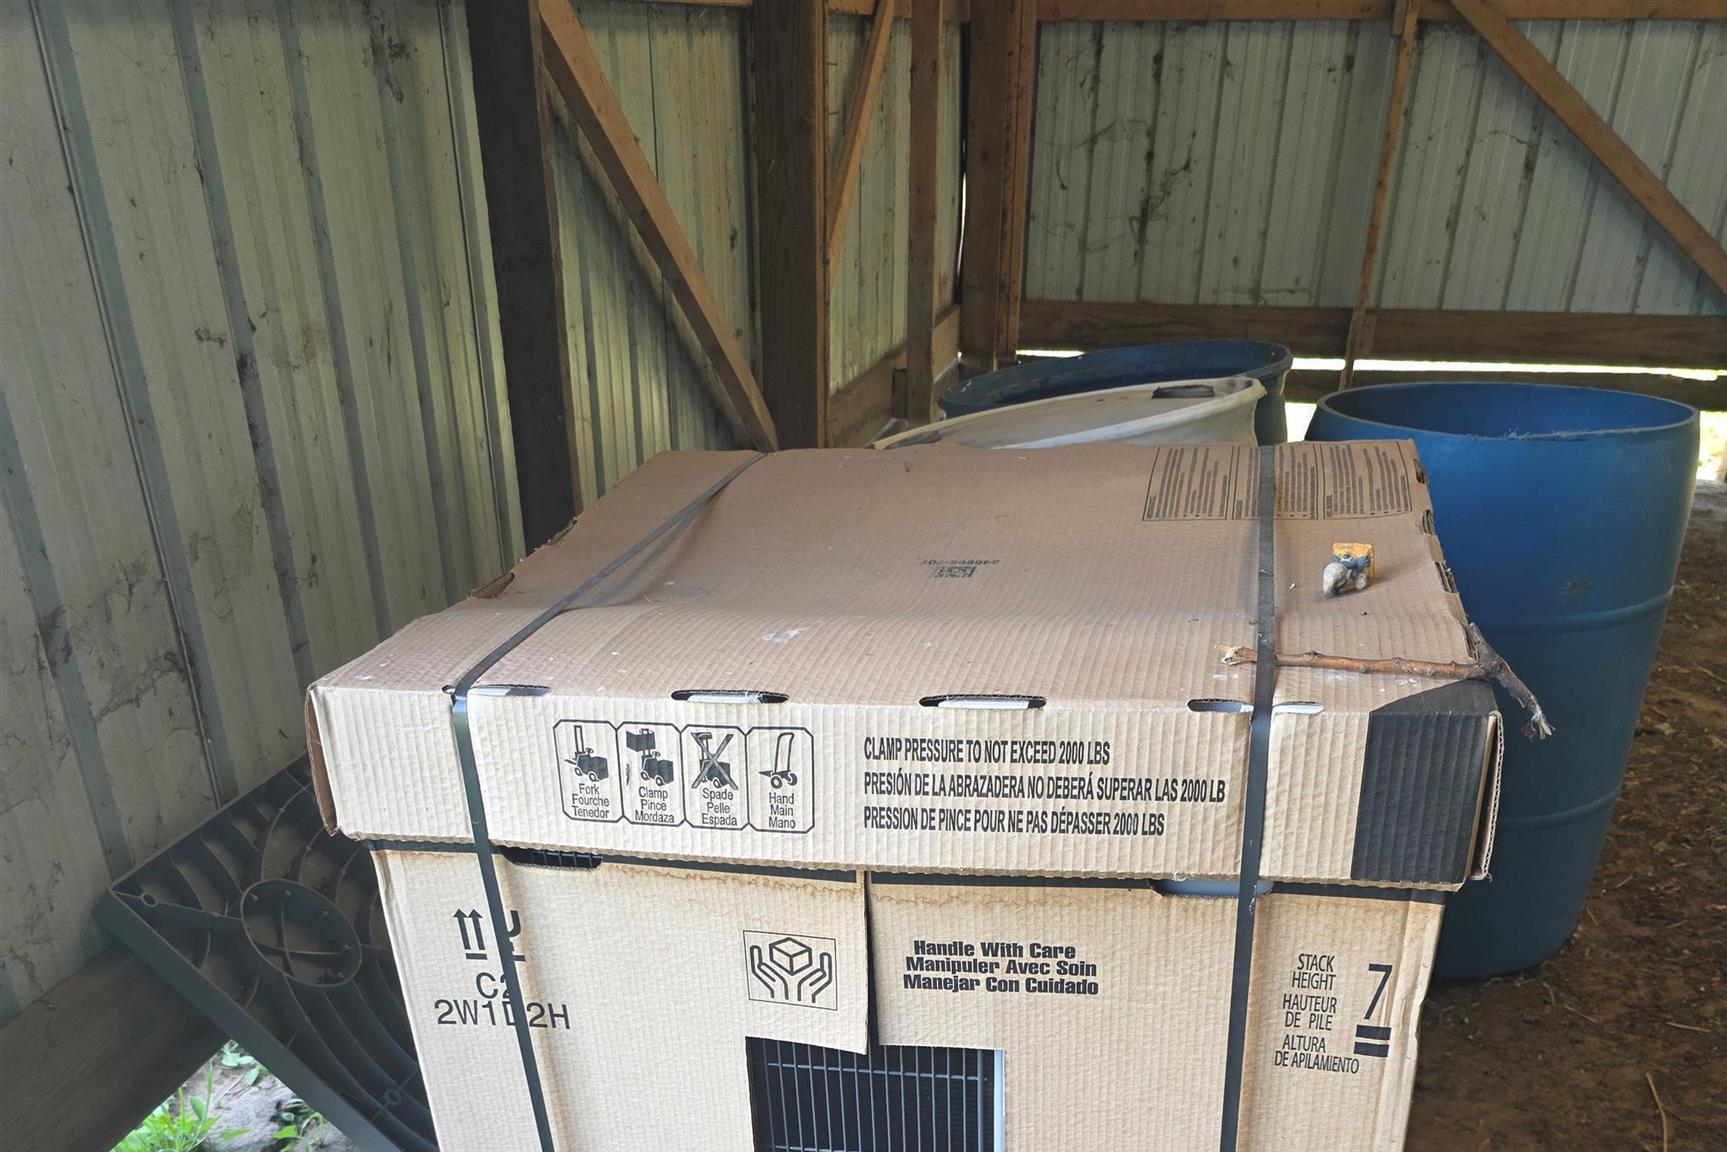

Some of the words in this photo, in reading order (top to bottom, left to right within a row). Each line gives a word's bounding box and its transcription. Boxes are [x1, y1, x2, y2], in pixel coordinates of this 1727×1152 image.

[864, 736, 902, 761] CLAMP
[904, 738, 963, 762] PRESSURE
[966, 739, 982, 763] TO
[984, 740, 1008, 763] NOT
[1010, 740, 1056, 764] EXCEED
[1058, 740, 1084, 765] 2000
[1087, 741, 1110, 765] LBS
[578, 783, 599, 795] Fork
[638, 786, 668, 801] Clamp
[702, 787, 734, 801] Spade
[864, 767, 912, 796] PRESIÓN
[914, 773, 929, 796] DE
[932, 773, 946, 796] LA
[949, 774, 1025, 799] ABRAZADERA
[1027, 775, 1044, 799] NO
[1047, 771, 1094, 800] DEBERÁ
[1096, 776, 1152, 801] SUPERAR
[1155, 778, 1178, 802] LAS
[1180, 778, 1207, 803] 2000
[1209, 779, 1226, 803] LB
[571, 793, 610, 807] Fourche
[640, 799, 667, 811] Pince
[768, 792, 795, 804] Hand
[571, 805, 610, 819] Tenedor
[635, 809, 675, 823] Mordaza
[707, 802, 731, 814] Pelle
[770, 804, 794, 816] Main
[701, 813, 737, 828] Espada
[768, 816, 796, 829] Mano
[864, 806, 918, 830] PRESSION
[920, 808, 936, 830] DE
[938, 808, 971, 832] PINCE
[974, 809, 1005, 833] POUR
[1007, 810, 1024, 833] NE
[1026, 811, 1048, 834] PAS
[1050, 806, 1111, 835] DÉPASSER
[1113, 812, 1139, 836] 2000
[1141, 813, 1165, 836] LBS
[913, 940, 975, 957] Handle
[980, 942, 1024, 958] With
[1029, 943, 1076, 959] Care
[905, 956, 1000, 975] Manipuler
[1005, 960, 1051, 975] Avec
[1056, 960, 1097, 977] Soin
[1297, 953, 1335, 972] STACK
[903, 974, 981, 993] Manejar
[985, 976, 1020, 993] Con
[1025, 977, 1099, 995] Cuidado
[1291, 971, 1337, 991] HEIGHT
[1363, 963, 1393, 1020] 7
[1282, 993, 1338, 1014] HAUTEUR
[1285, 1011, 1301, 1028] DE
[1308, 1013, 1333, 1031] PILE
[1282, 1034, 1326, 1053] ALTURA
[1274, 1050, 1289, 1067] DE
[1291, 1052, 1360, 1074] APILAMIENTO
